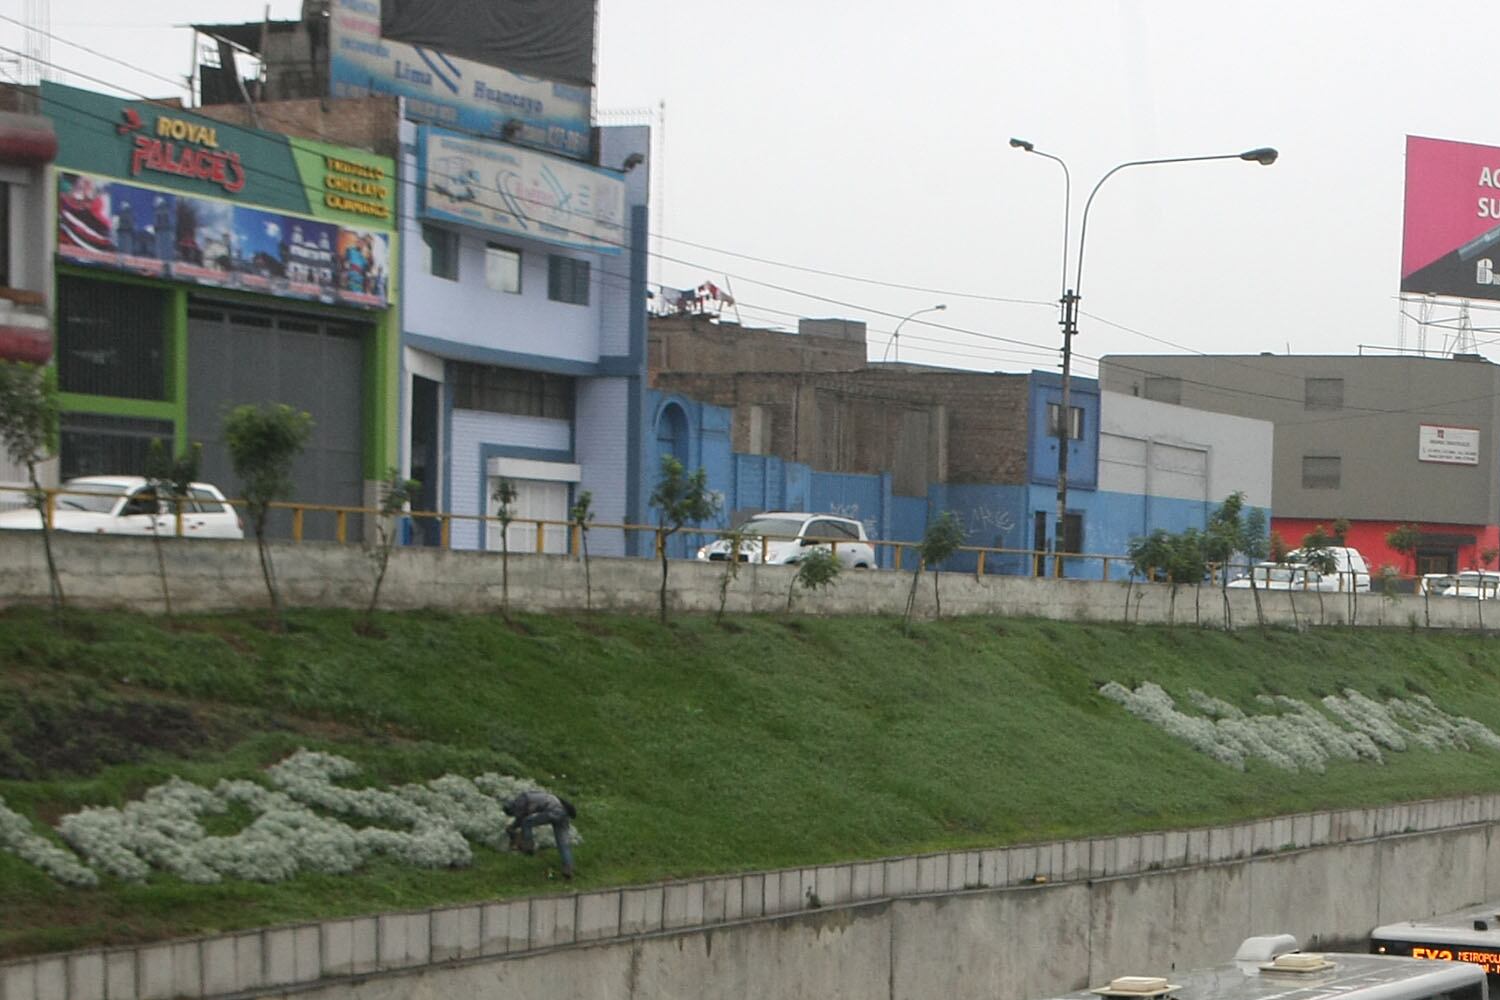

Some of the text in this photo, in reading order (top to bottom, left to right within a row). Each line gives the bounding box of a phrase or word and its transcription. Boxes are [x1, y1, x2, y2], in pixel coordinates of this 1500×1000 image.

[395, 60, 433, 86] Lima
[473, 80, 543, 113] Huancayo
[157, 116, 219, 148] ROYAL
[325, 175, 388, 200] CHICLAYO
